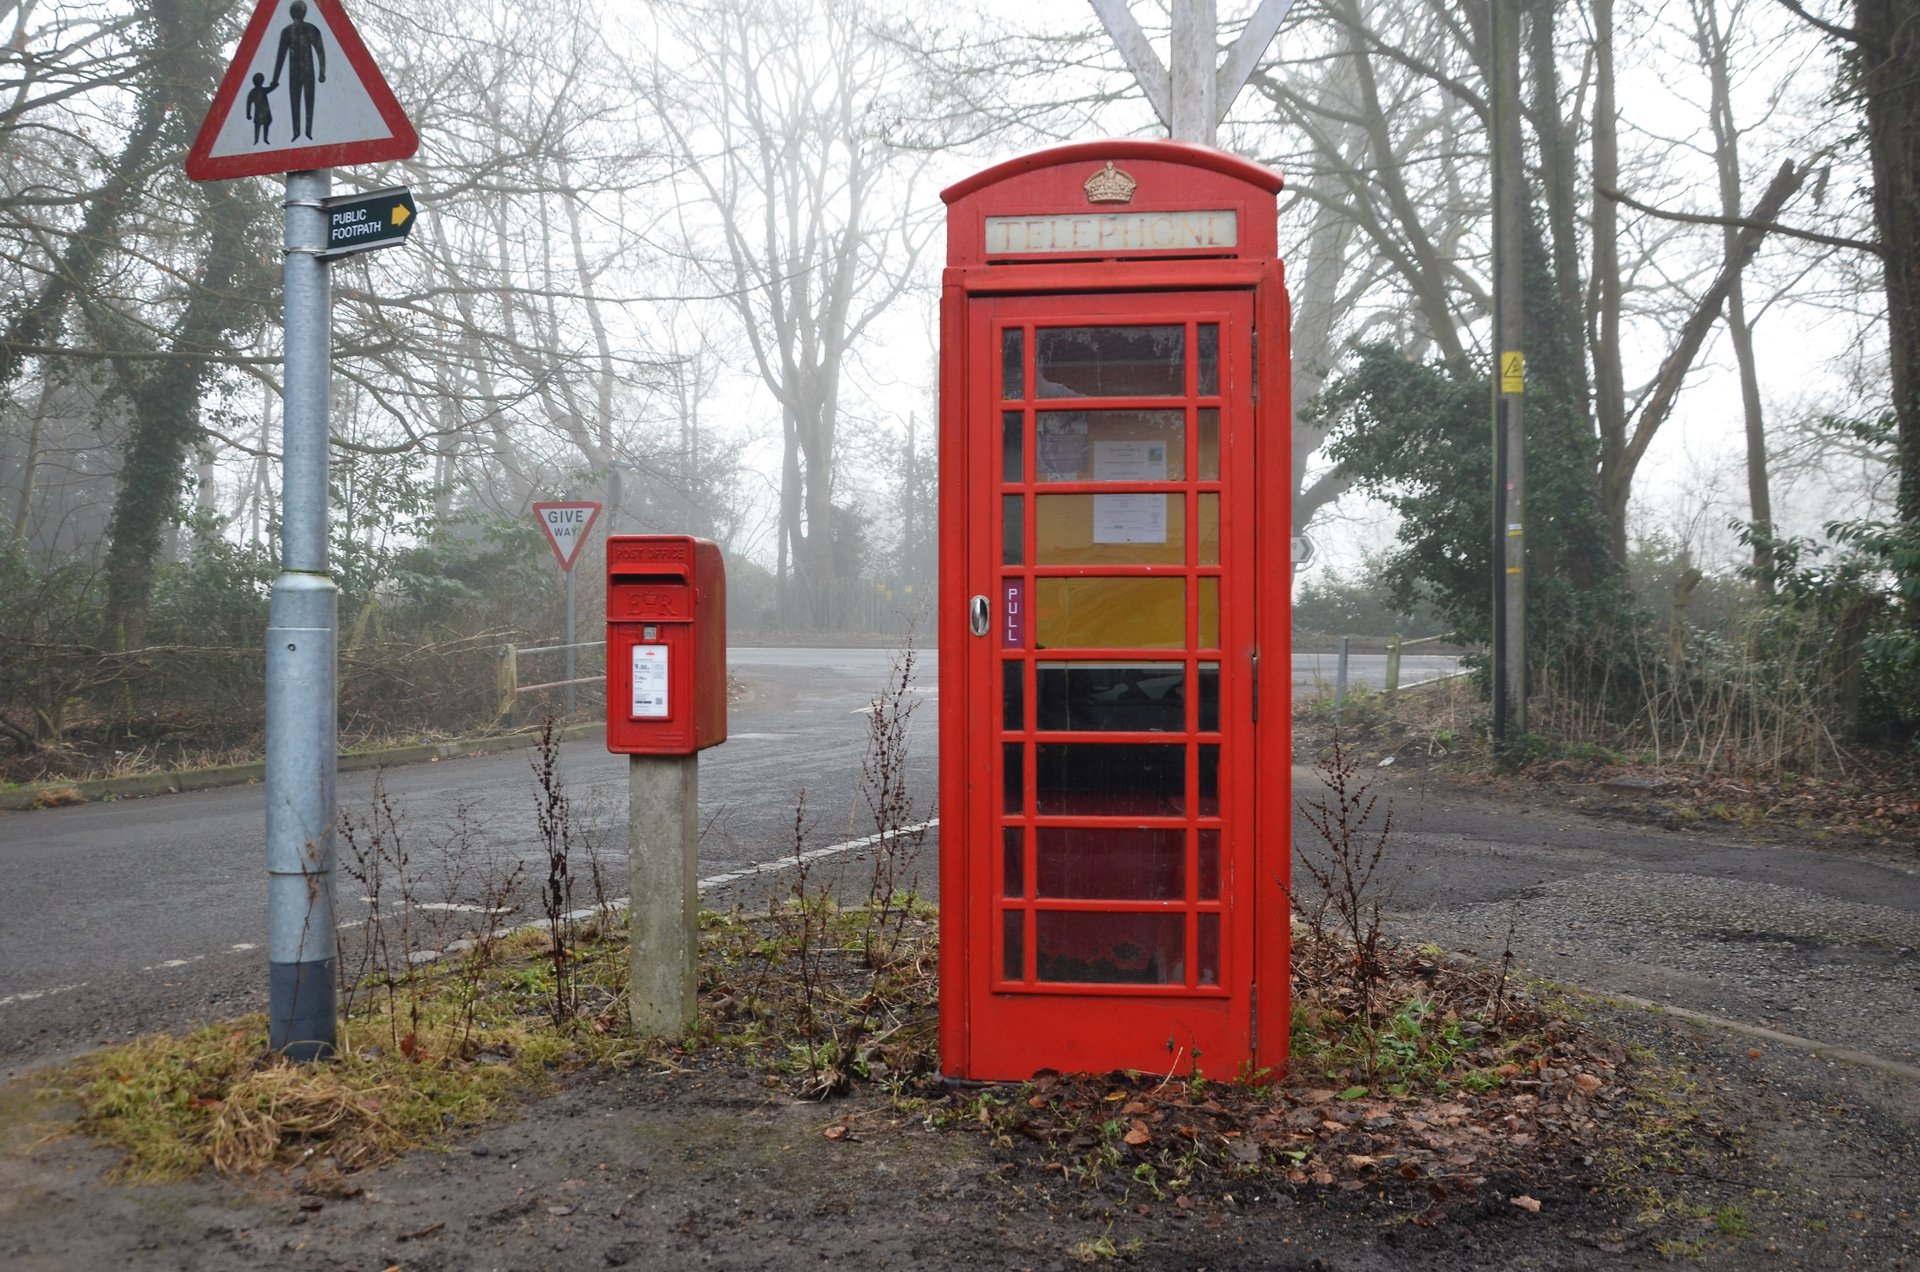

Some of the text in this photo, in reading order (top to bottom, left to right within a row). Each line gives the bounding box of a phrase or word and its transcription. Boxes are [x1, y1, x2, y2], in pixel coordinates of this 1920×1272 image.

[332, 209, 367, 225] PUBLIC
[332, 221, 381, 240] FOOTPATH
[997, 216, 1231, 250] TELEPHONE
[548, 510, 583, 523] GIVE
[554, 527, 577, 537] WAY
[617, 547, 644, 560] POST
[1008, 588, 1018, 641] PULL
